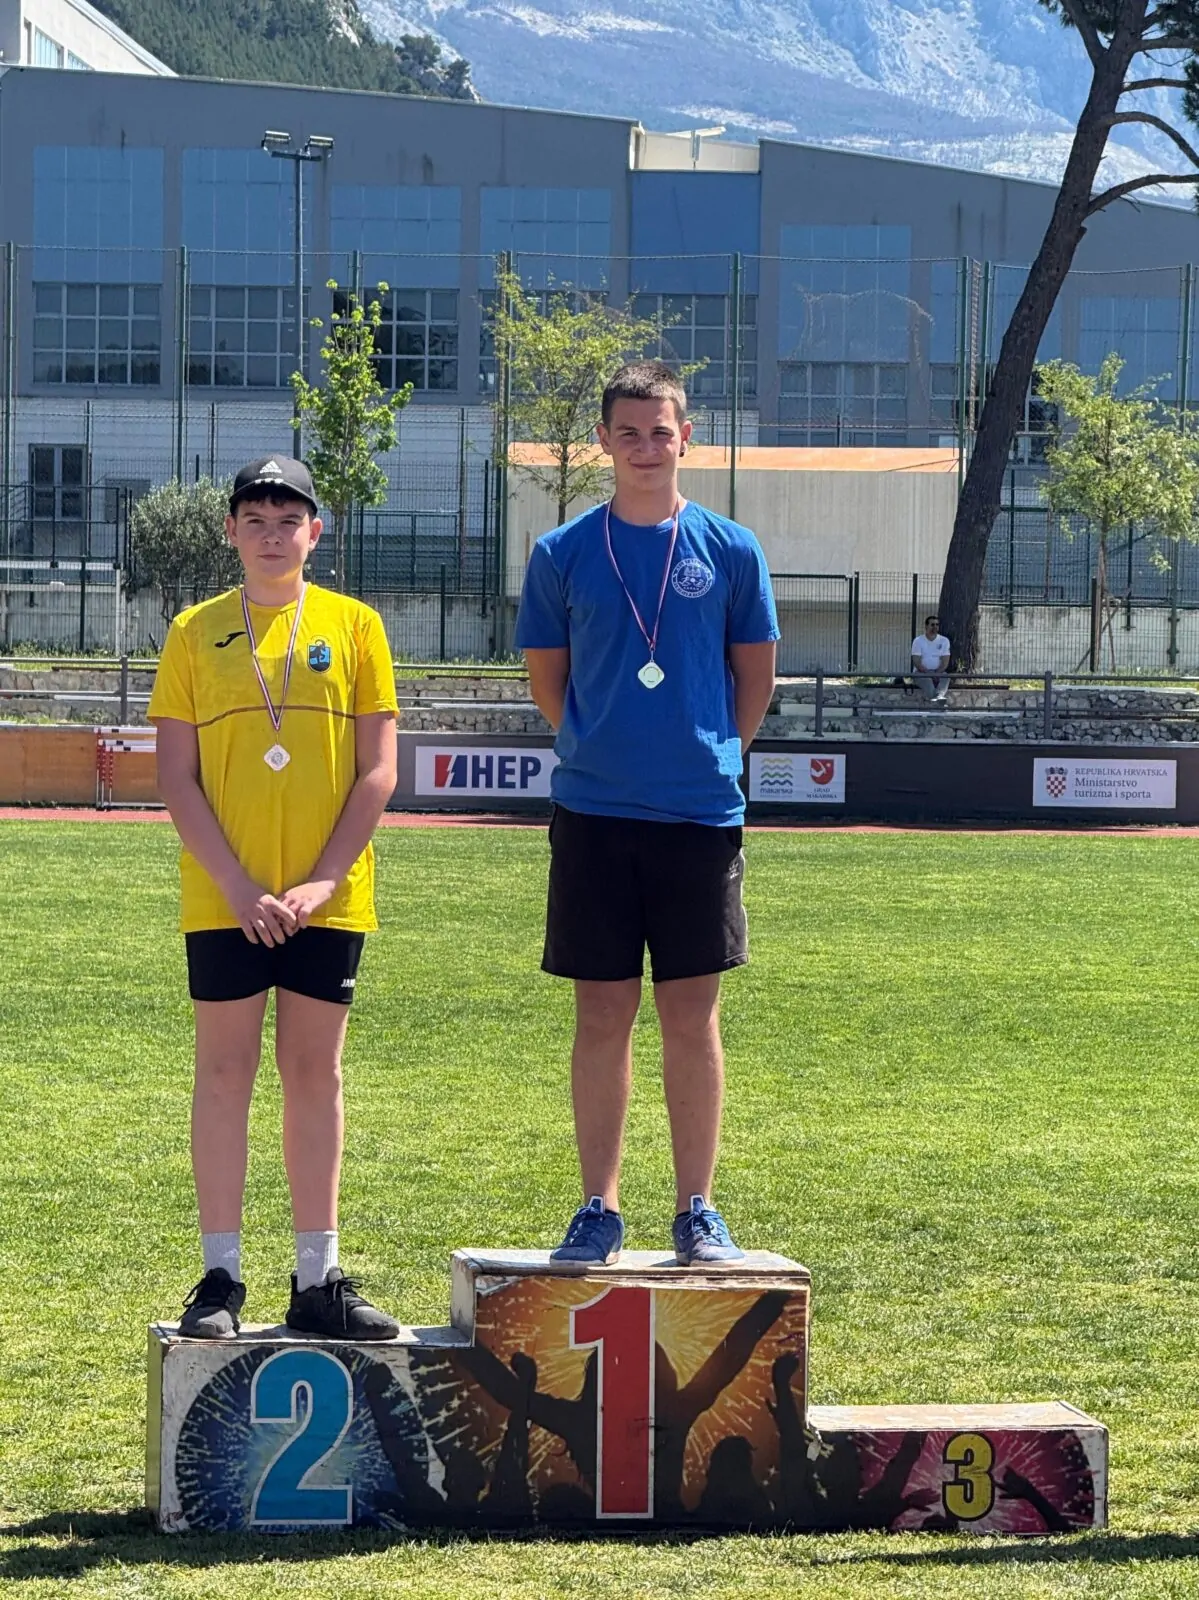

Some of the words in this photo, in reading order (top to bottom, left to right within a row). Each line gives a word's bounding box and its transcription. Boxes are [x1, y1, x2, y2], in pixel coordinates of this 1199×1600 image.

[471, 755, 541, 789] HEP
[1075, 768, 1121, 776] REPUBLIKA
[1124, 769, 1168, 777] HRVATSKA
[1075, 778, 1138, 787] Ministarstvo
[1075, 789, 1112, 798] turizma
[1120, 791, 1151, 800] sporta
[569, 1286, 655, 1520] 1
[249, 1349, 354, 1527] 2
[942, 1433, 995, 1522] 3
